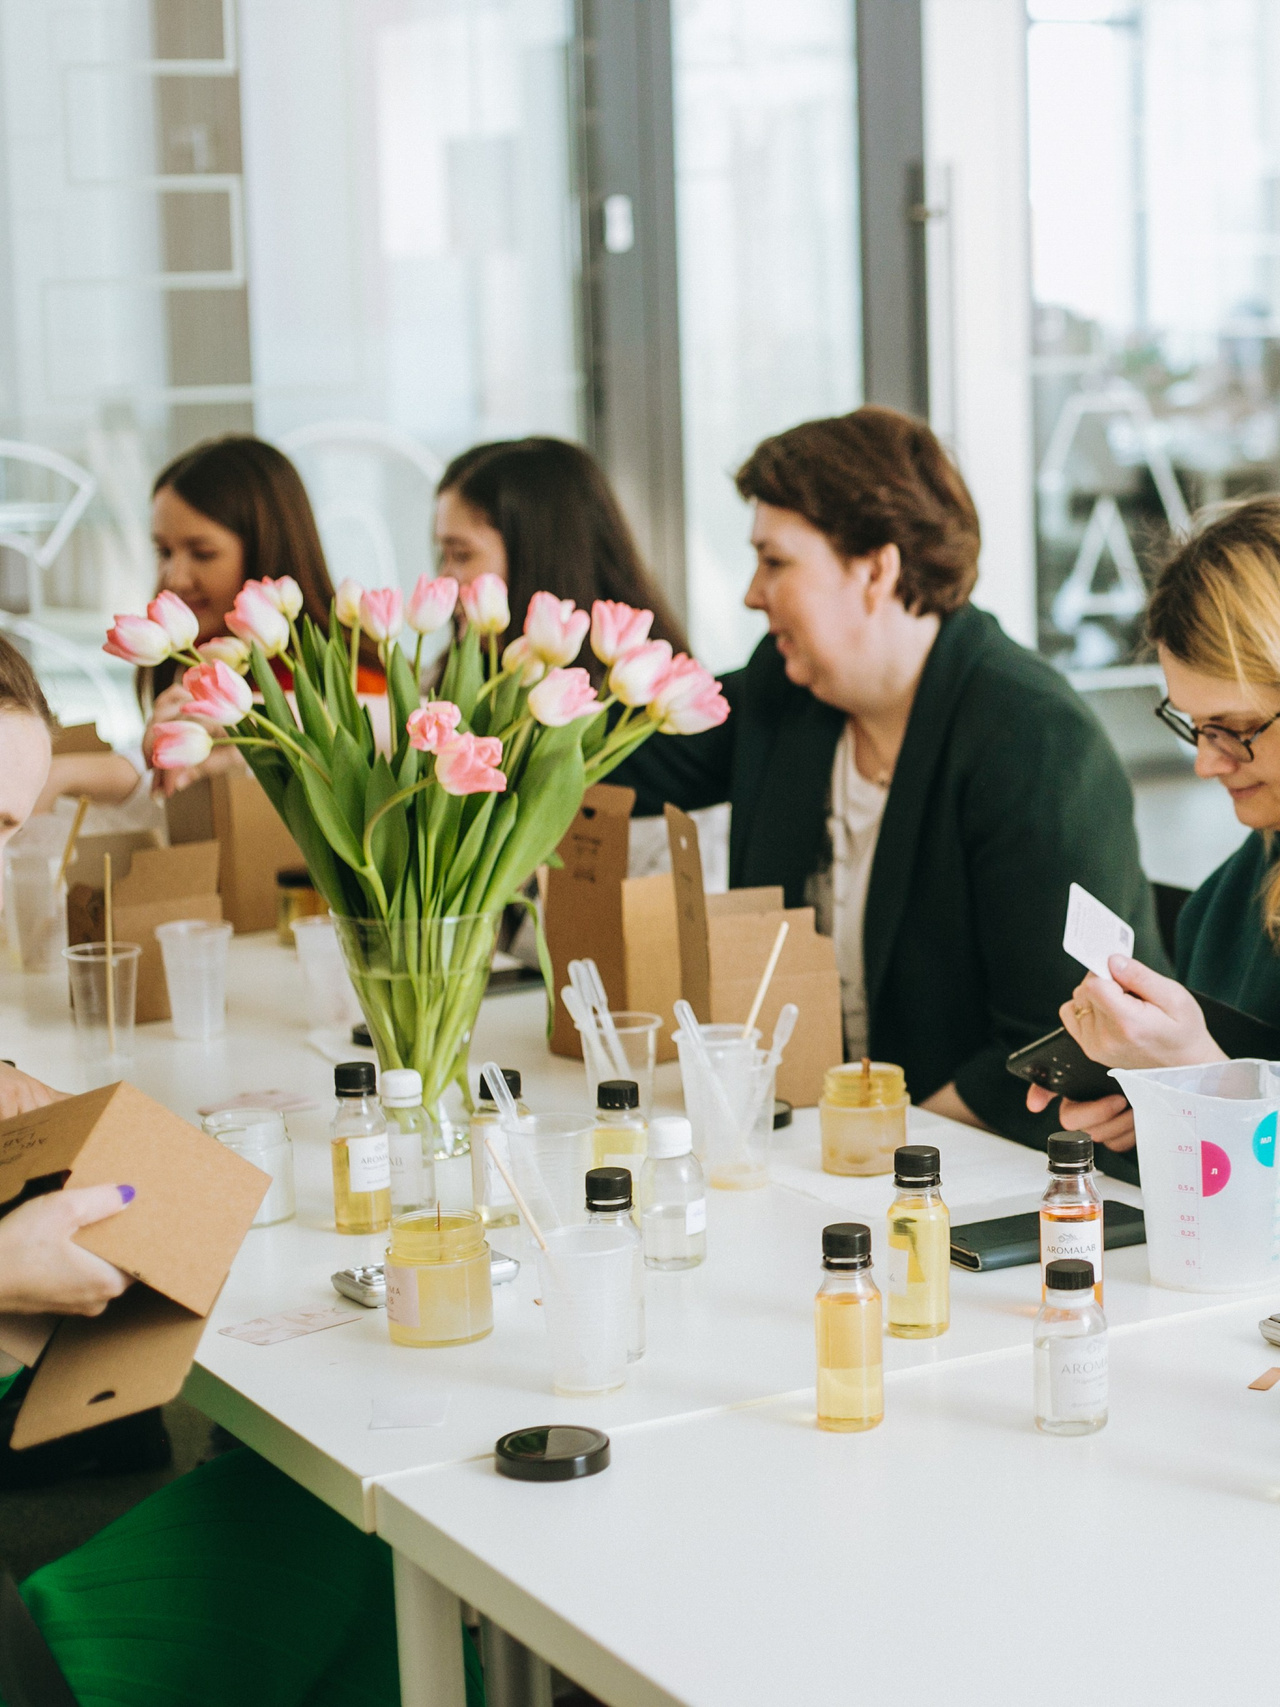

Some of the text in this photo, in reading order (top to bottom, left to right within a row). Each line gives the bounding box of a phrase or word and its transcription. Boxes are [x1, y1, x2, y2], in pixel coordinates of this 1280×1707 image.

[1260, 1136, 1272, 1144] мл
[1210, 1167, 1218, 1175] л
[1046, 1243, 1097, 1255] AROMALAB
[1061, 1357, 1107, 1375] AROM
